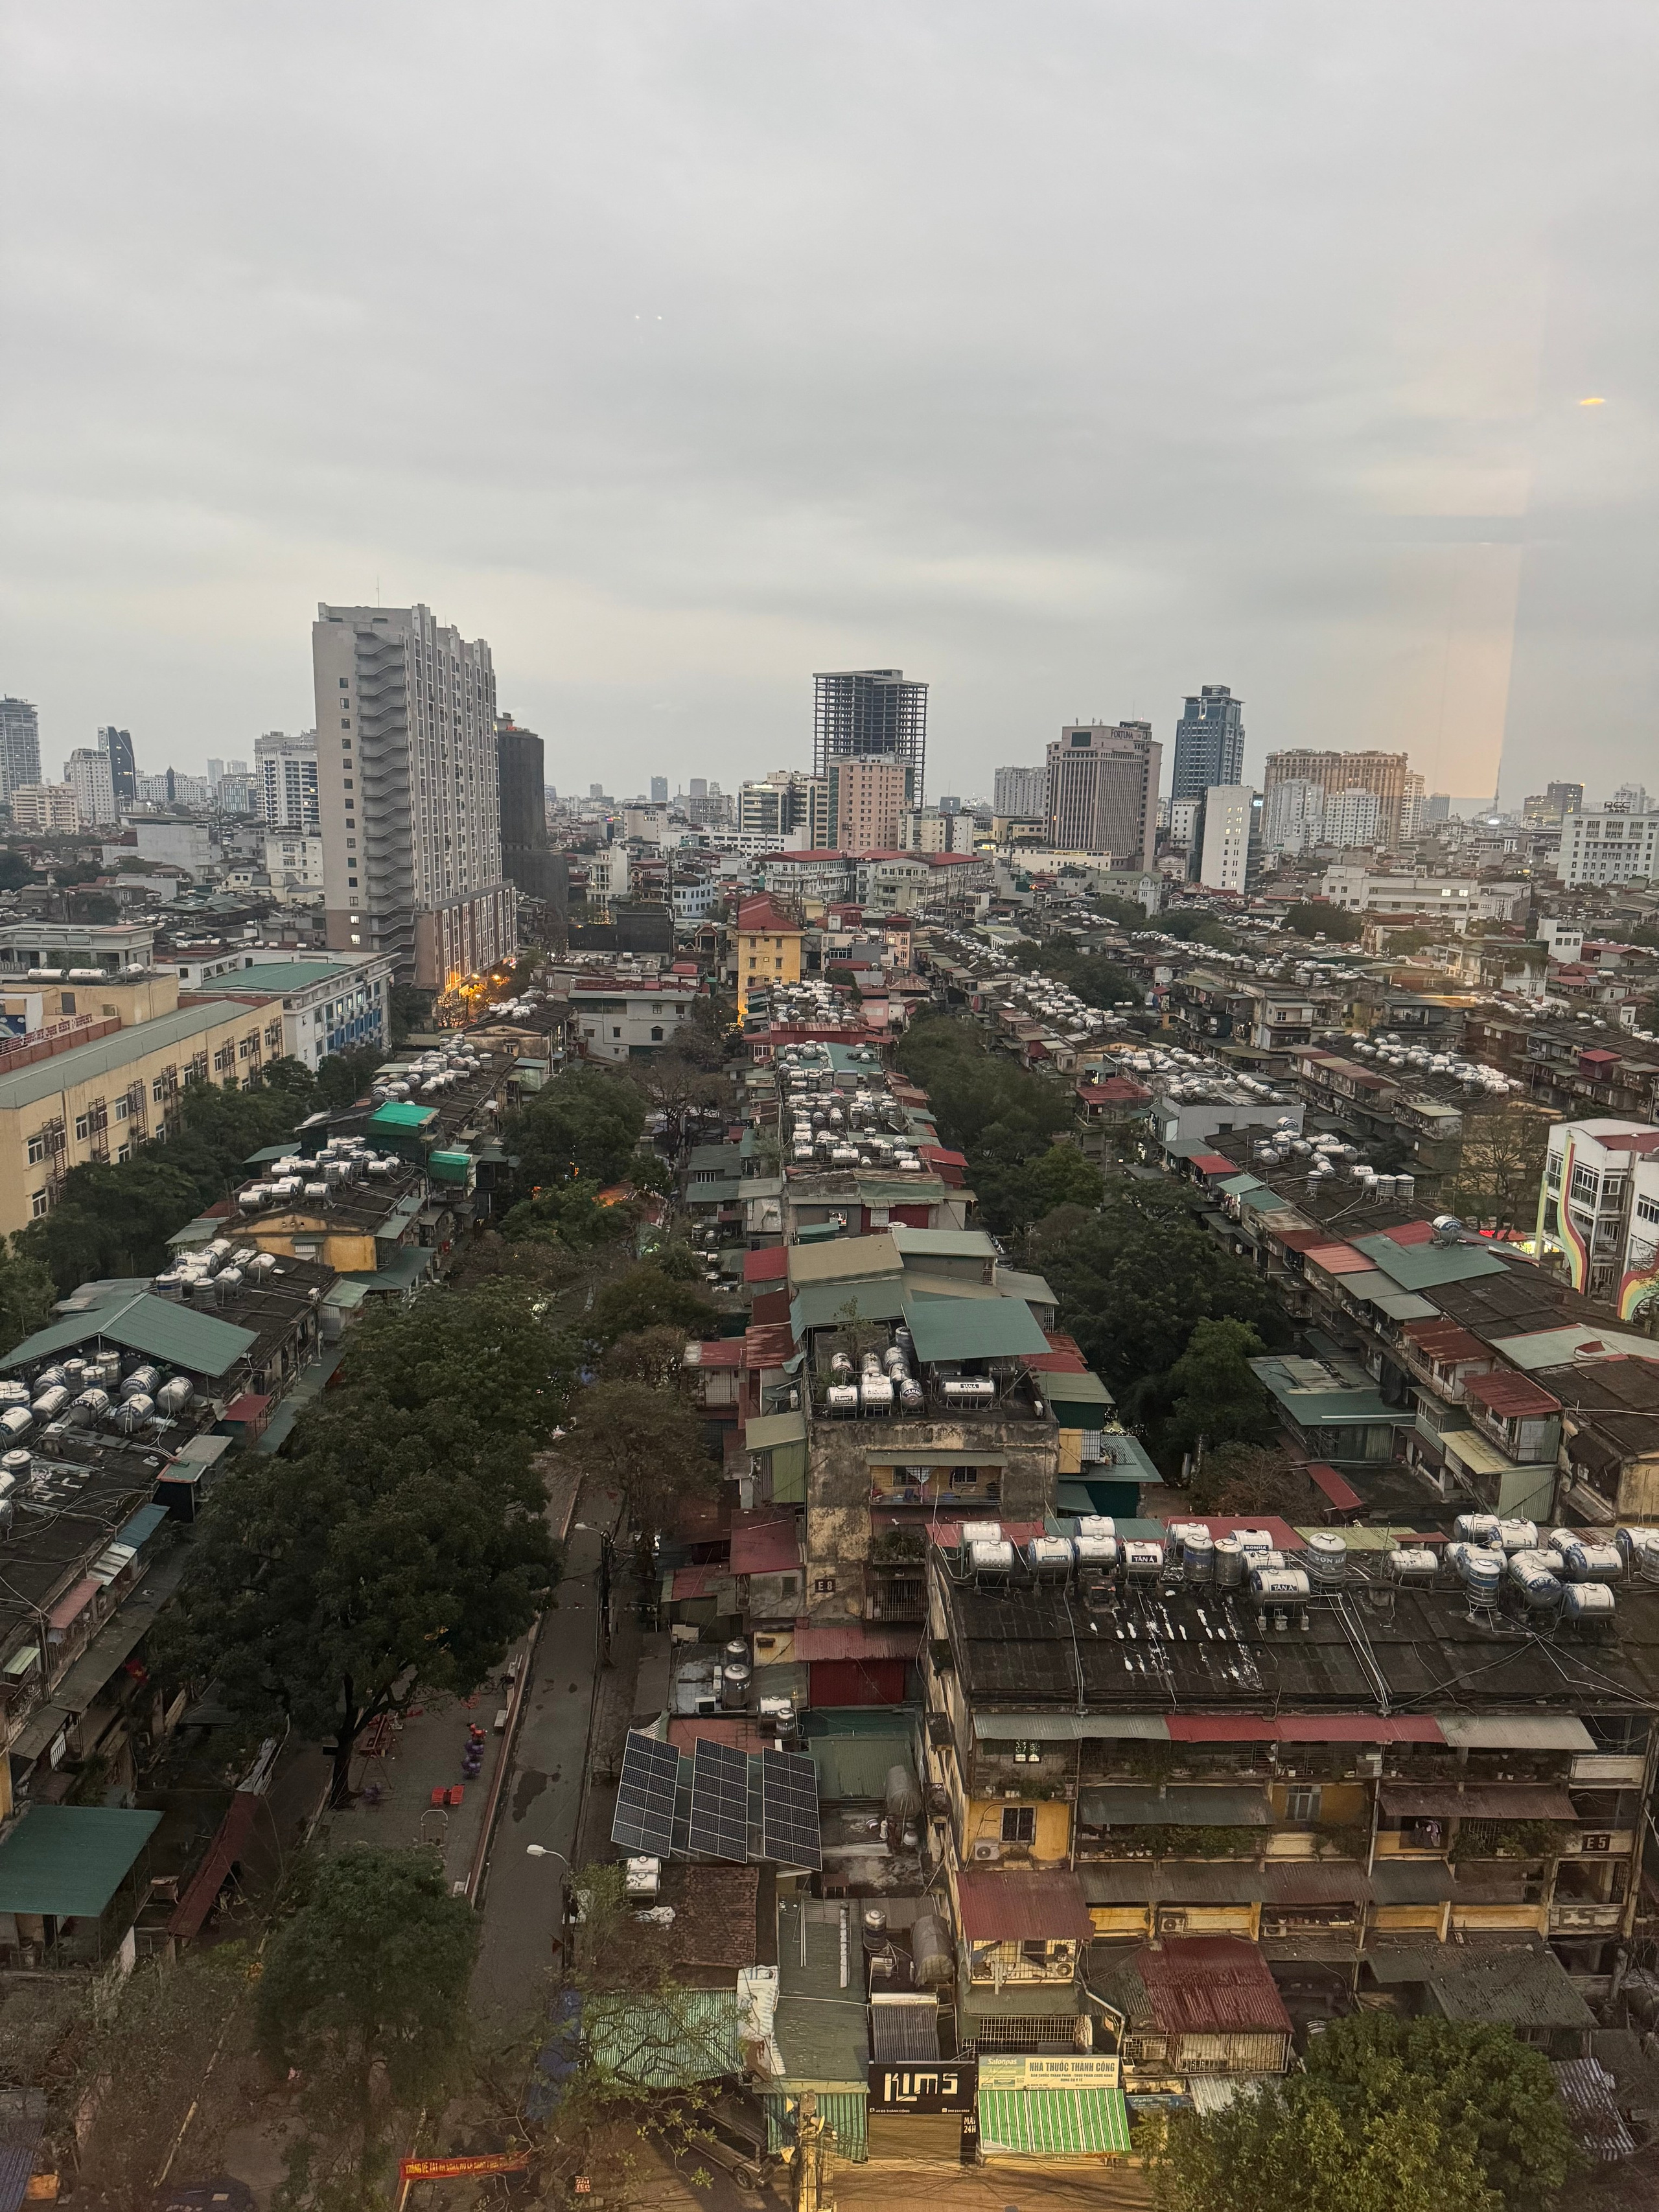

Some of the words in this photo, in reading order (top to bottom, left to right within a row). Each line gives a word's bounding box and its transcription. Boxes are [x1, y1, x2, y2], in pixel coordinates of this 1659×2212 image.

[818, 1581, 824, 1590] E
[827, 1581, 833, 1590] 8
[1586, 1837, 1594, 1849] E
[1597, 1837, 1607, 1849] 5
[1095, 2060, 1115, 2072] CÔNG
[964, 2125, 976, 2134] 24H
